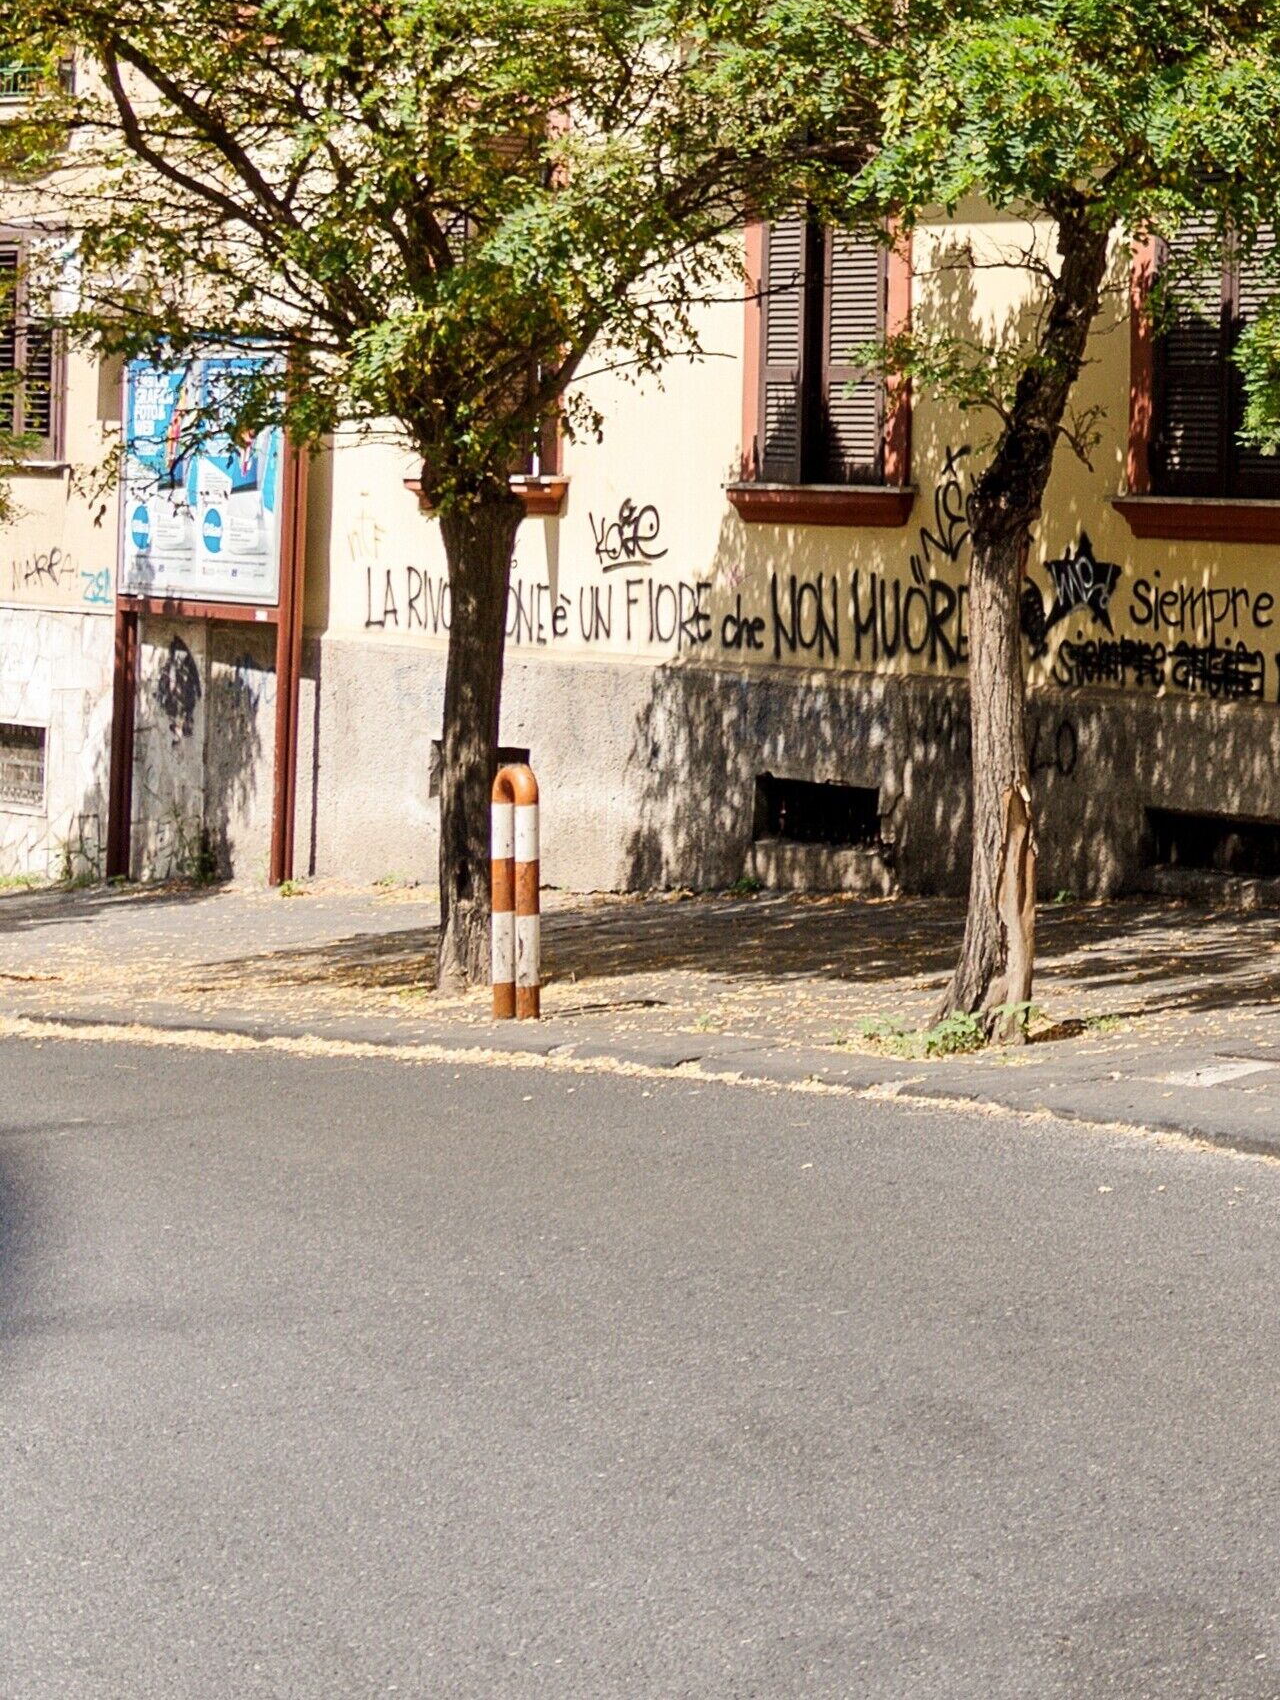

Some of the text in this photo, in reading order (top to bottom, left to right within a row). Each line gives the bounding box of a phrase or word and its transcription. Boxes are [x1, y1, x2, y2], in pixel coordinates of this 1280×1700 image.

[365, 566, 398, 628] LA
[579, 584, 612, 642] UN
[626, 578, 713, 652] FIORE
[721, 593, 765, 650] che
[771, 571, 839, 661] NON
